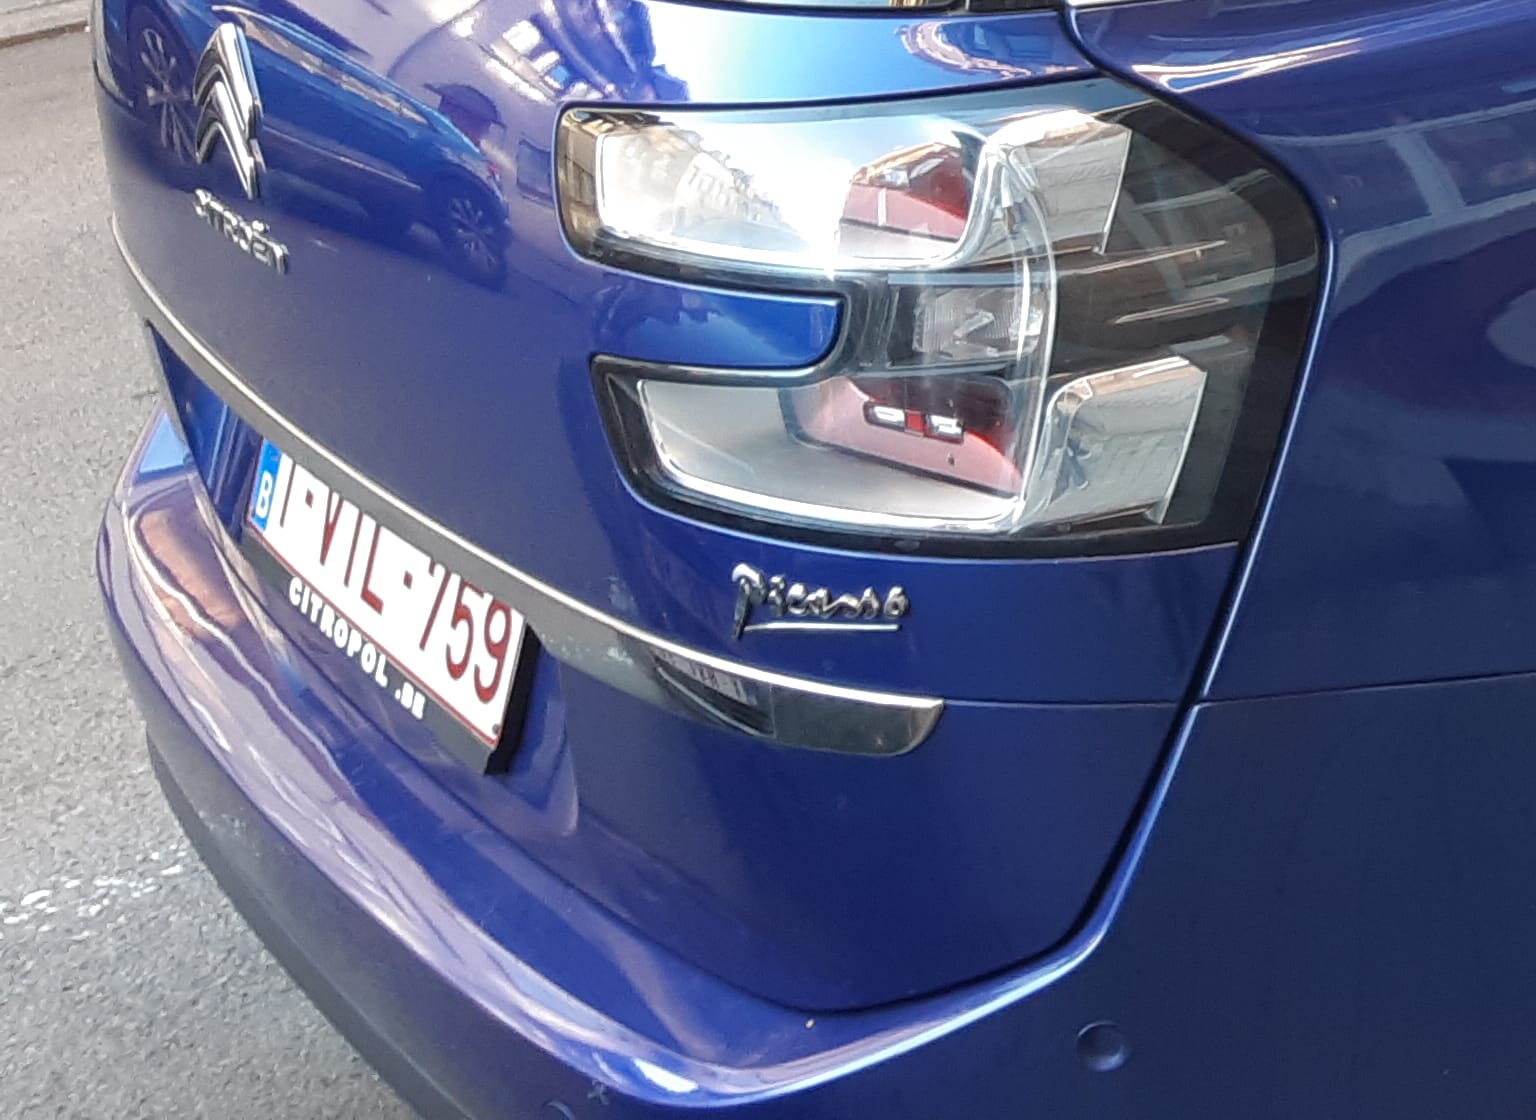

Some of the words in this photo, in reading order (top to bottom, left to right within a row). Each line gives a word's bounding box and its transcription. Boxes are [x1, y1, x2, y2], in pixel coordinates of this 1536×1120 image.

[255, 470, 273, 520] B
[288, 576, 389, 688] CITROPOL
[731, 562, 910, 639] Picasso
